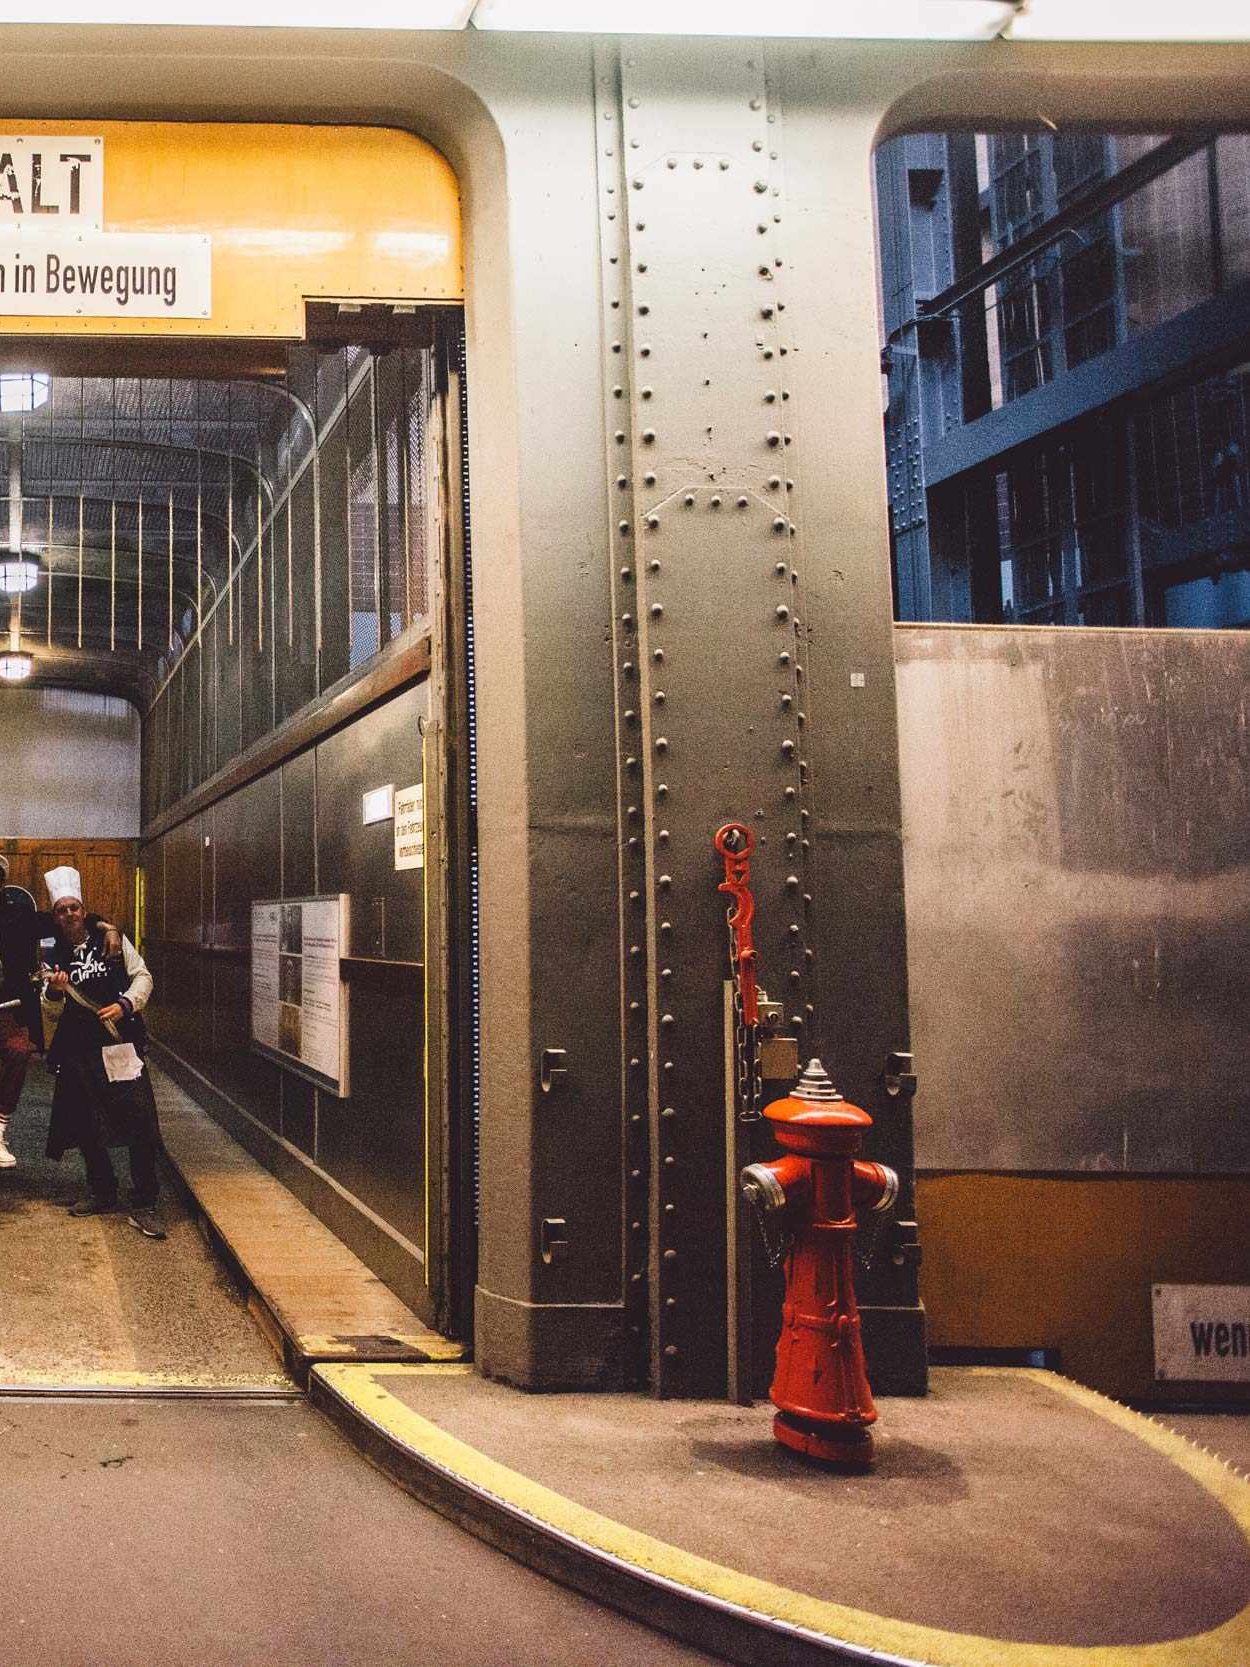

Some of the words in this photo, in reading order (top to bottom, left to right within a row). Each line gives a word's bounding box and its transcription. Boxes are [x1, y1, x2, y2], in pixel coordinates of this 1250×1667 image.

[14, 253, 36, 293] in
[45, 254, 177, 306] Bewegung
[1190, 1320, 1250, 1358] wen
